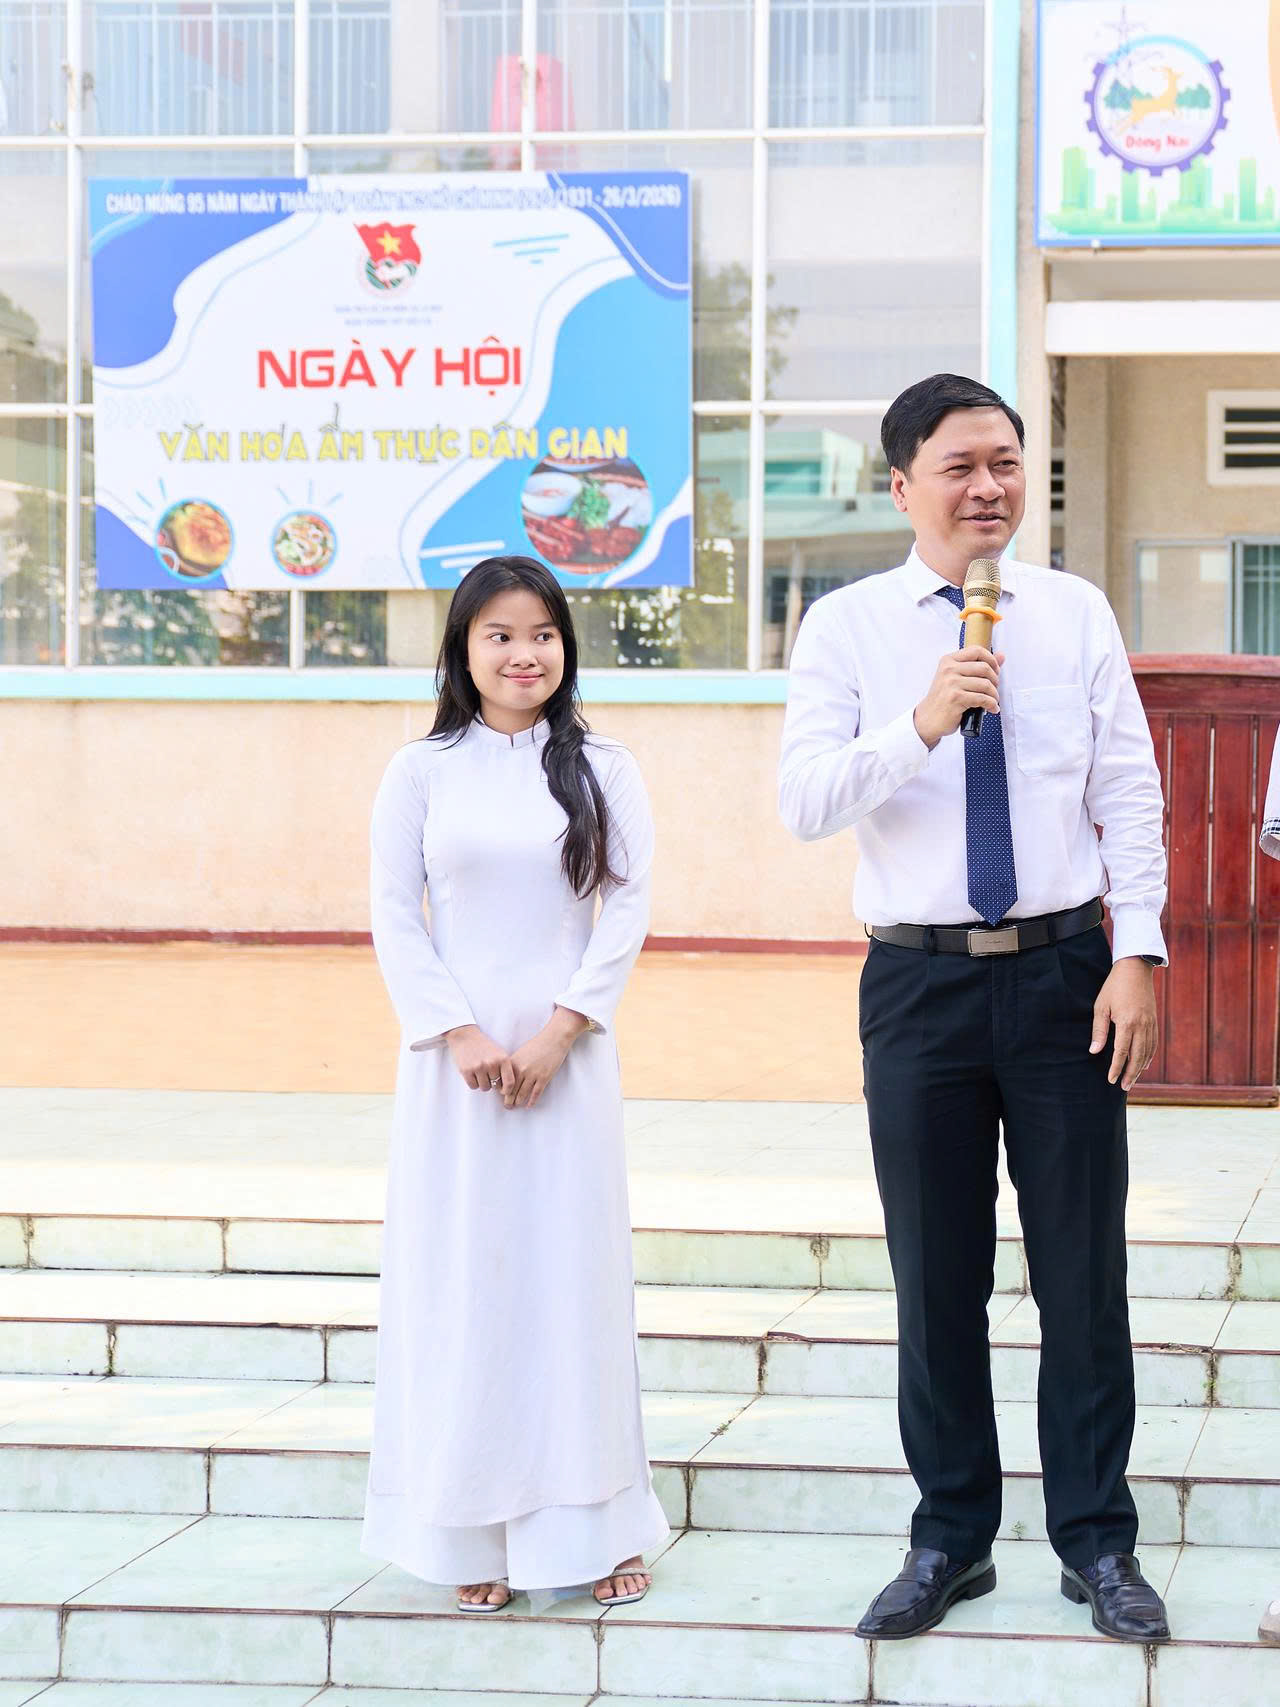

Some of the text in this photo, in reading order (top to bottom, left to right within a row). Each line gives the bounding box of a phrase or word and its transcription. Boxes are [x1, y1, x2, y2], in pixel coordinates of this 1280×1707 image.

[258, 335, 521, 396] NGÀY HỘI
[158, 423, 230, 462] VĂN
[372, 423, 460, 463] THỰC
[468, 421, 539, 460] DÂN
[547, 427, 628, 460] GIAN
